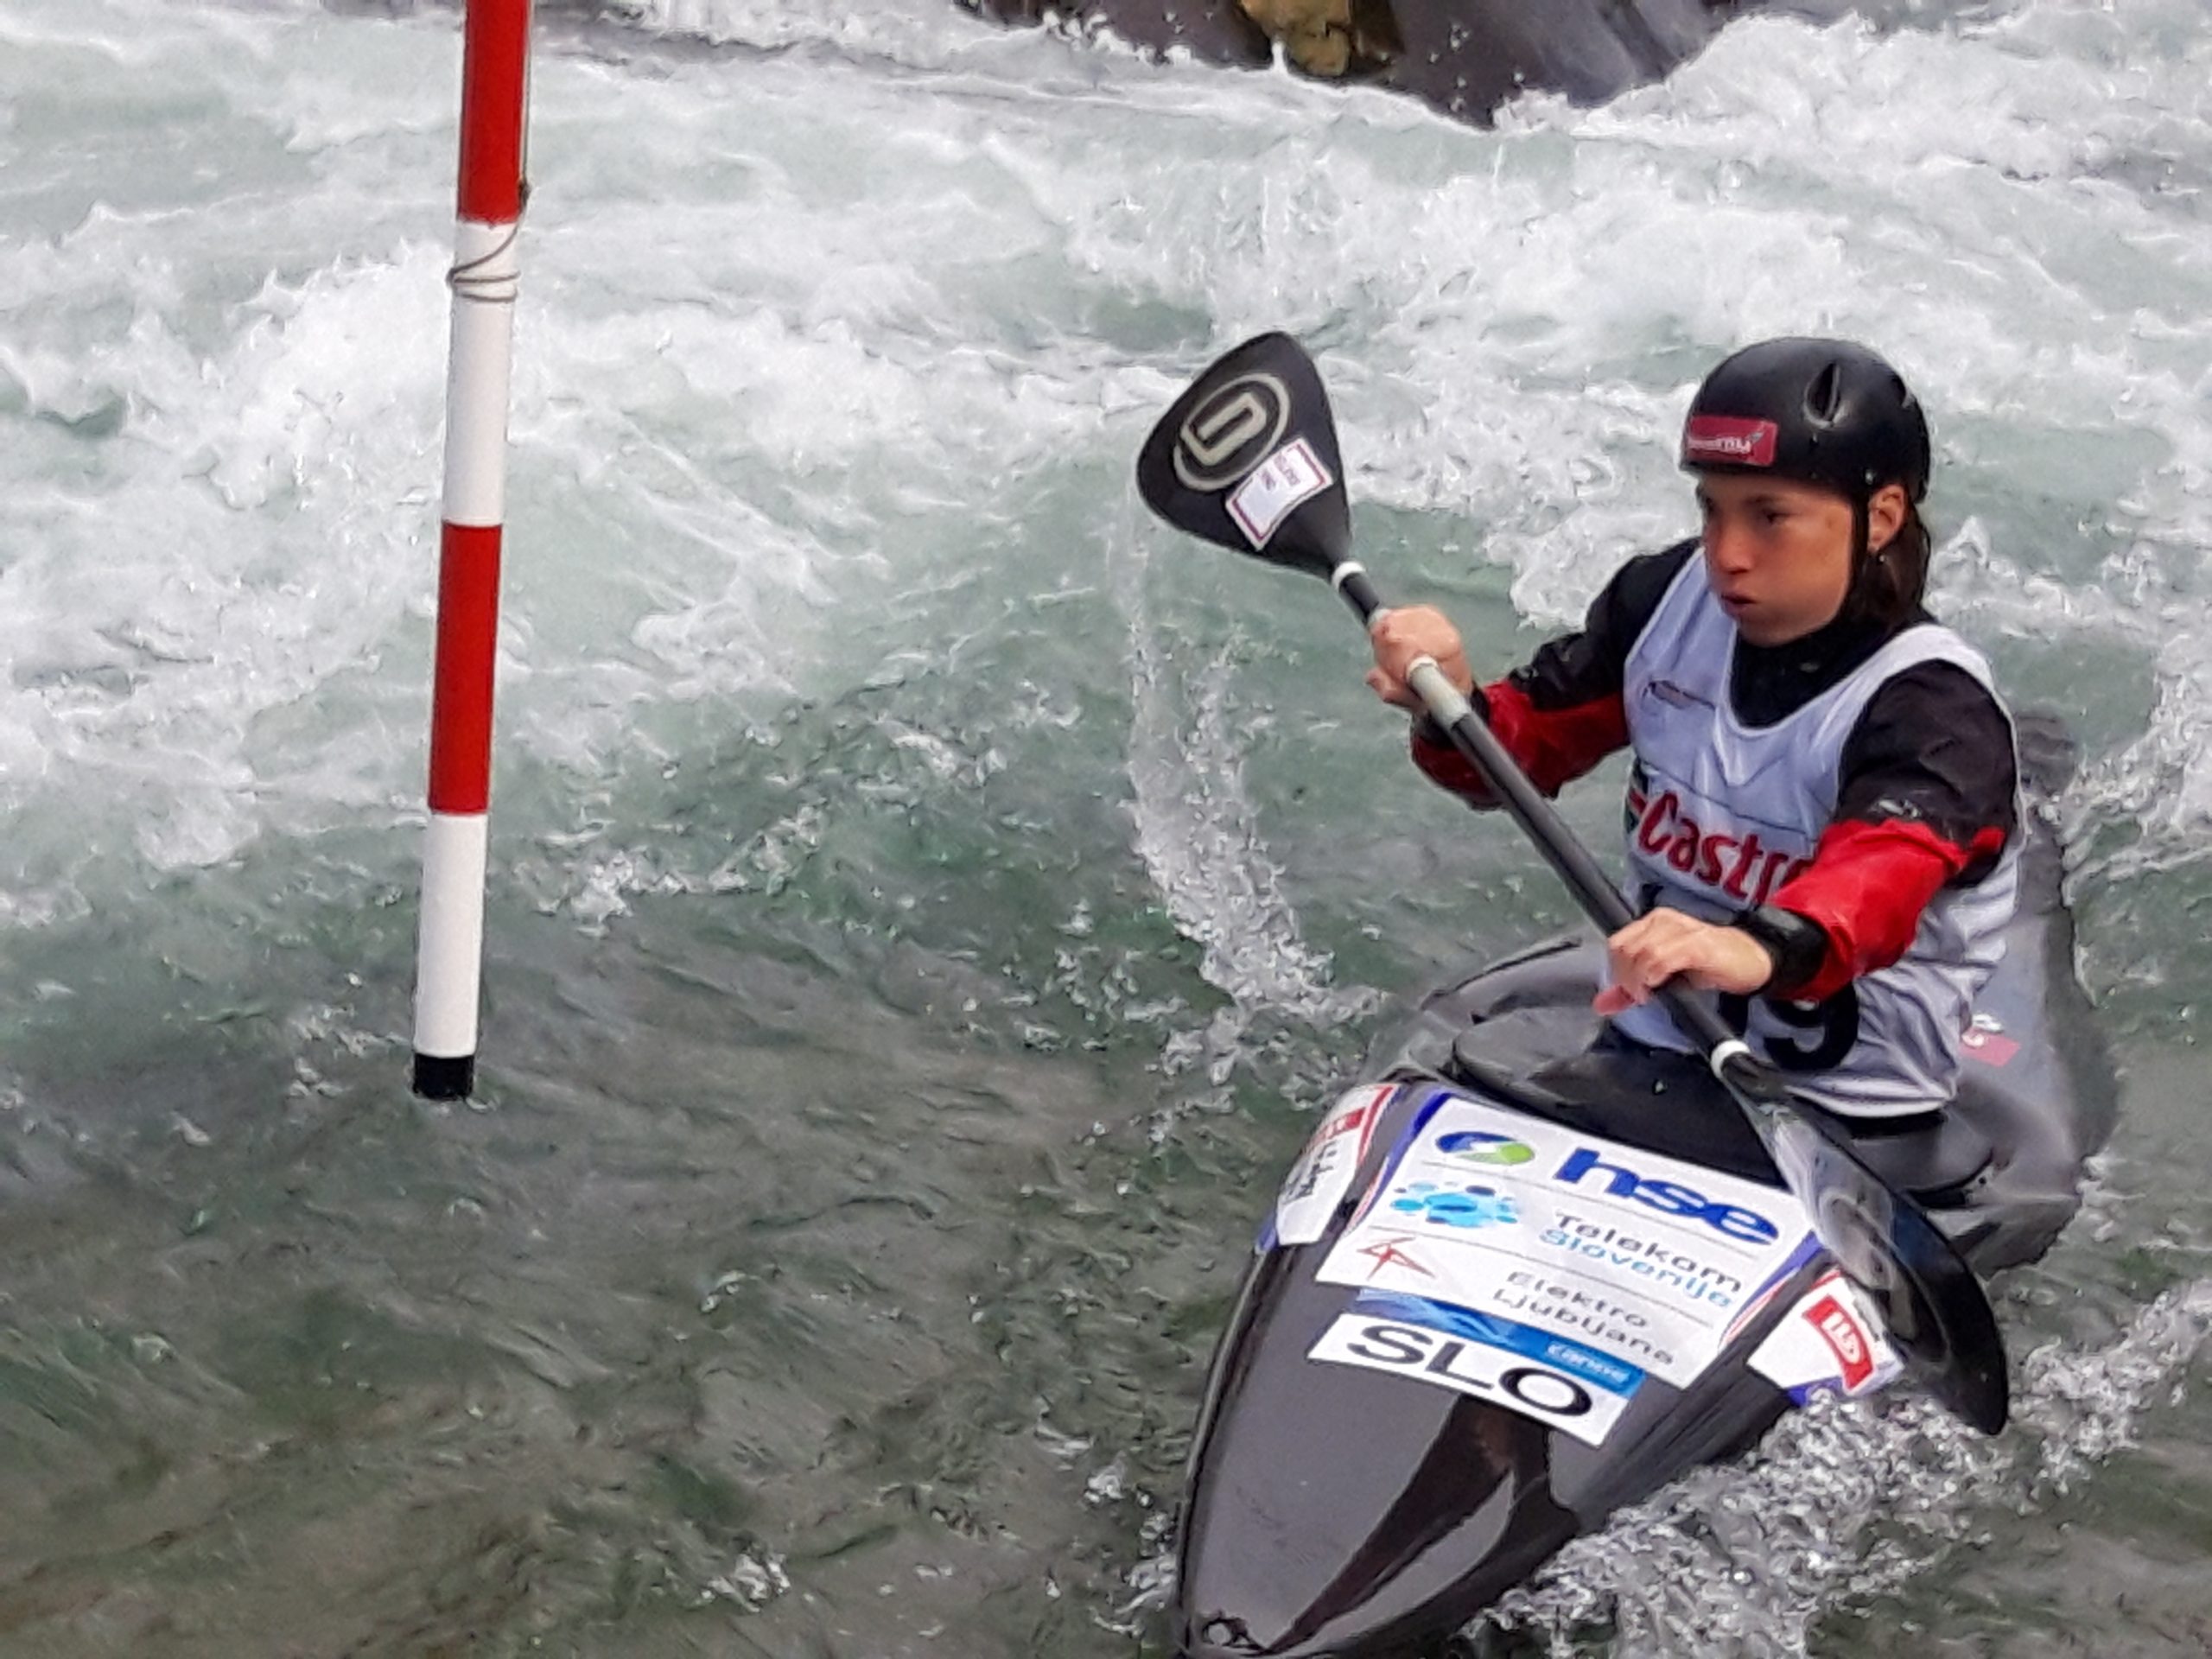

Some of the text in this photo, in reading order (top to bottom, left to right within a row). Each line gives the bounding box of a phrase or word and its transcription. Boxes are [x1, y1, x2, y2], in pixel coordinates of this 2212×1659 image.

[1553, 1147, 1780, 1245] hse
[1539, 1229, 1732, 1306] Slovenije
[1555, 1210, 1742, 1293] Telekom
[1493, 1288, 1674, 1365] Ljubljana
[1507, 1271, 1647, 1327] Elektro
[1346, 1324, 1592, 1416] SLO
